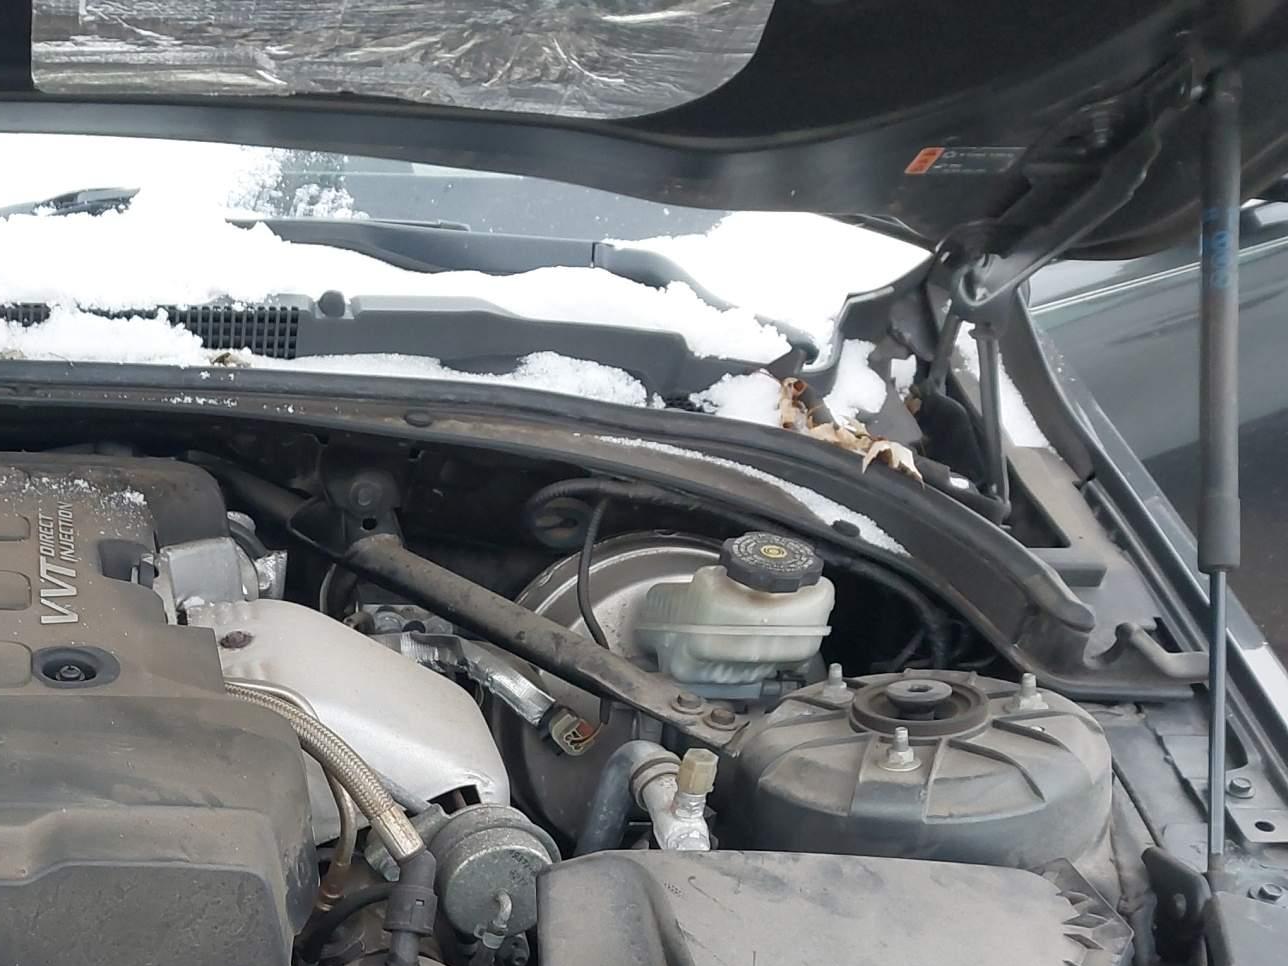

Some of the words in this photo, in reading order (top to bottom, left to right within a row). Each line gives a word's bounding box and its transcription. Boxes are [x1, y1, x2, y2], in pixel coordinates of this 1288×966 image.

[39, 513, 55, 557] DIRECT
[57, 501, 78, 562] INJECTION
[39, 555, 79, 624] VVT
